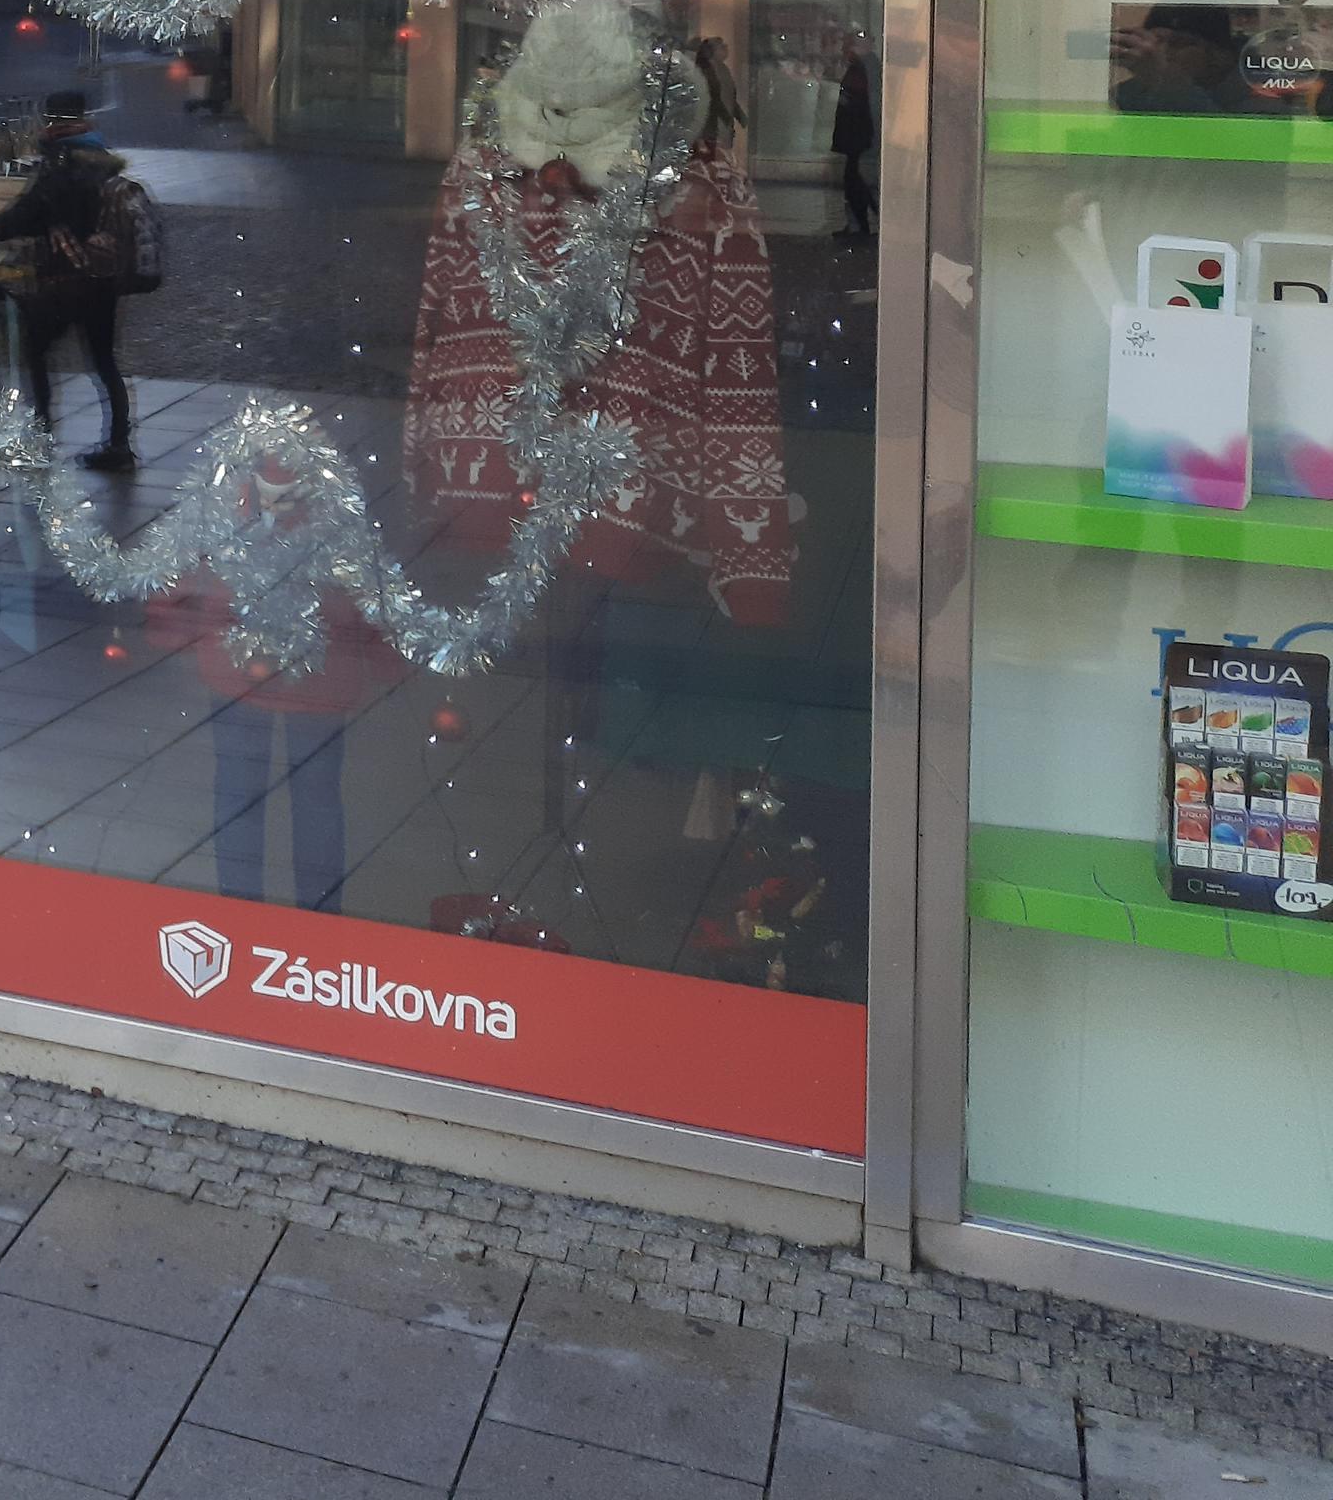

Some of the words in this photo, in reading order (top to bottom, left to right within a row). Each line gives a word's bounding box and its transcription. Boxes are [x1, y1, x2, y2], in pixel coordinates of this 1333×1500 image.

[1246, 56, 1315, 70] LIQUA
[1262, 78, 1296, 89] MIX
[1188, 657, 1305, 687] LIQUA
[1177, 751, 1206, 761] LIQUA
[1216, 755, 1245, 764] LIQUA
[1255, 760, 1284, 770] LIQUA
[1291, 763, 1321, 773] LIQUA
[1180, 810, 1209, 820] LIQUA
[1215, 814, 1244, 823] LIQUA
[250, 944, 518, 1041] Zásilkovna
